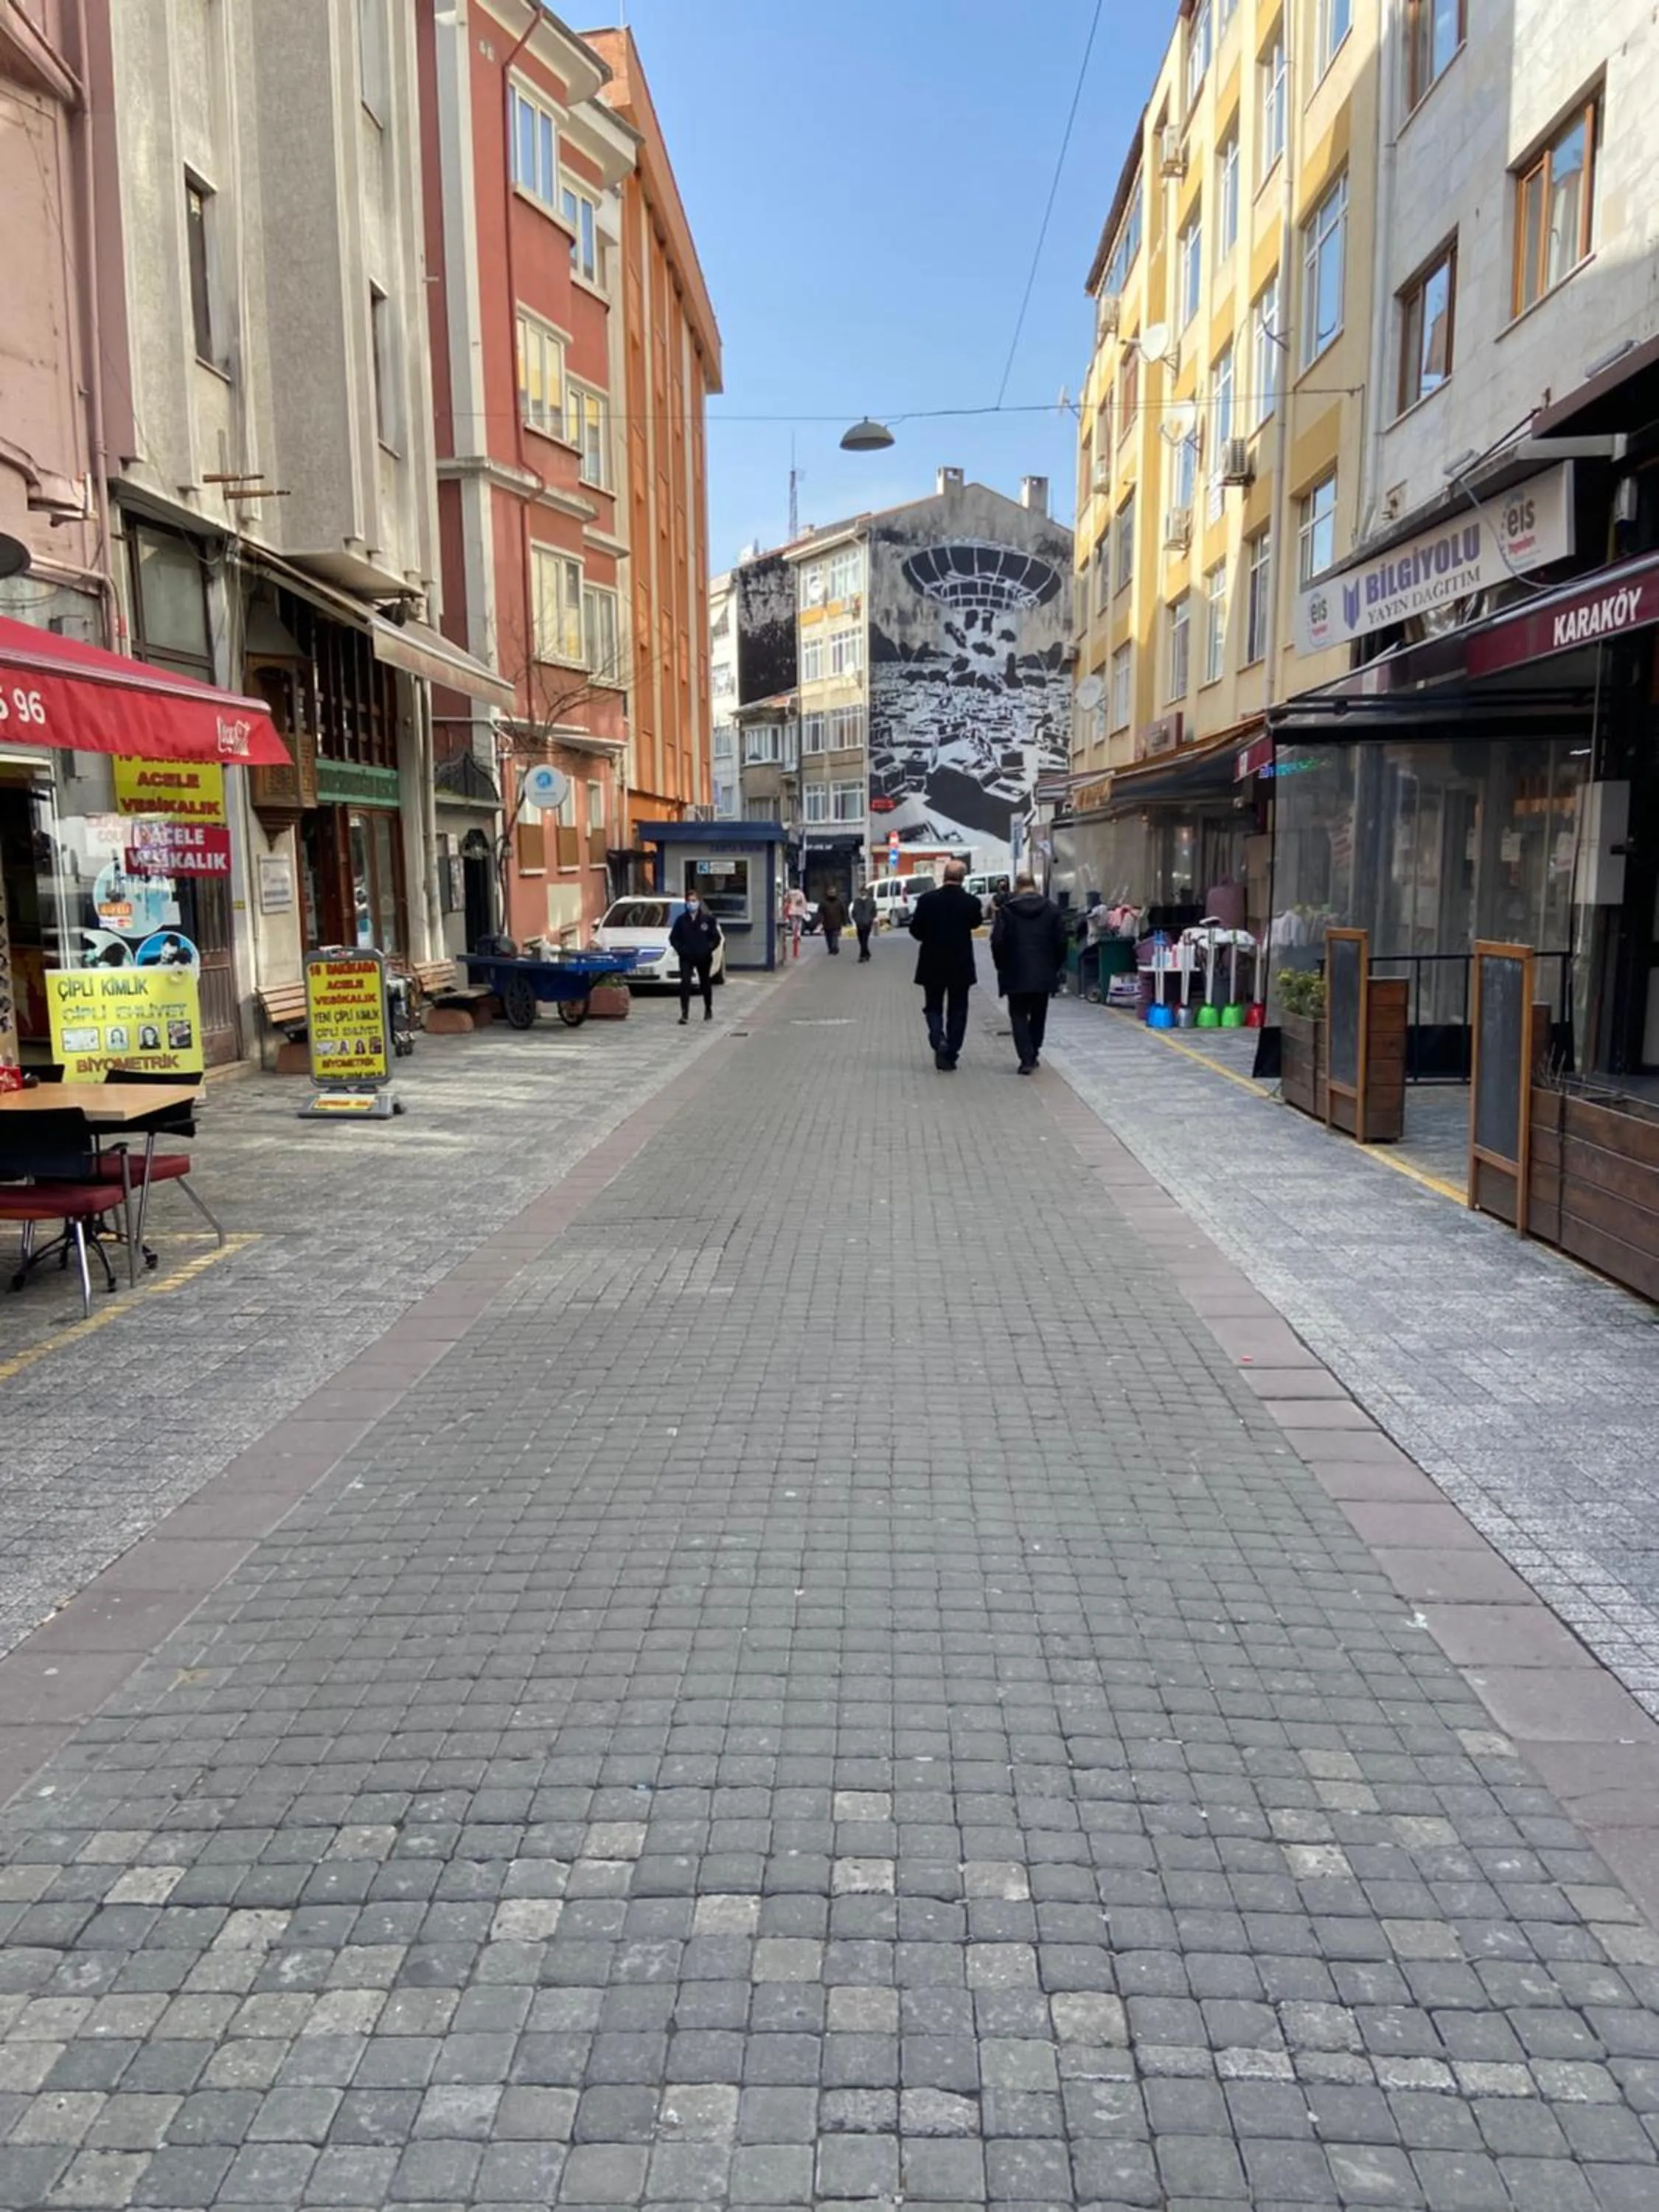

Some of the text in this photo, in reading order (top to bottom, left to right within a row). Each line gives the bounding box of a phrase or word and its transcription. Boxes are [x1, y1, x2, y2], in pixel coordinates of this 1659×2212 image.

[1366, 523, 1480, 606] BİLGİYOLU
[1368, 598, 1408, 625] YAYIN
[1553, 587, 1643, 647] KARAKÖY
[13, 687, 46, 724] 96
[136, 771, 200, 788] ACELE
[76, 1054, 179, 1074] BİYOMETRİK
